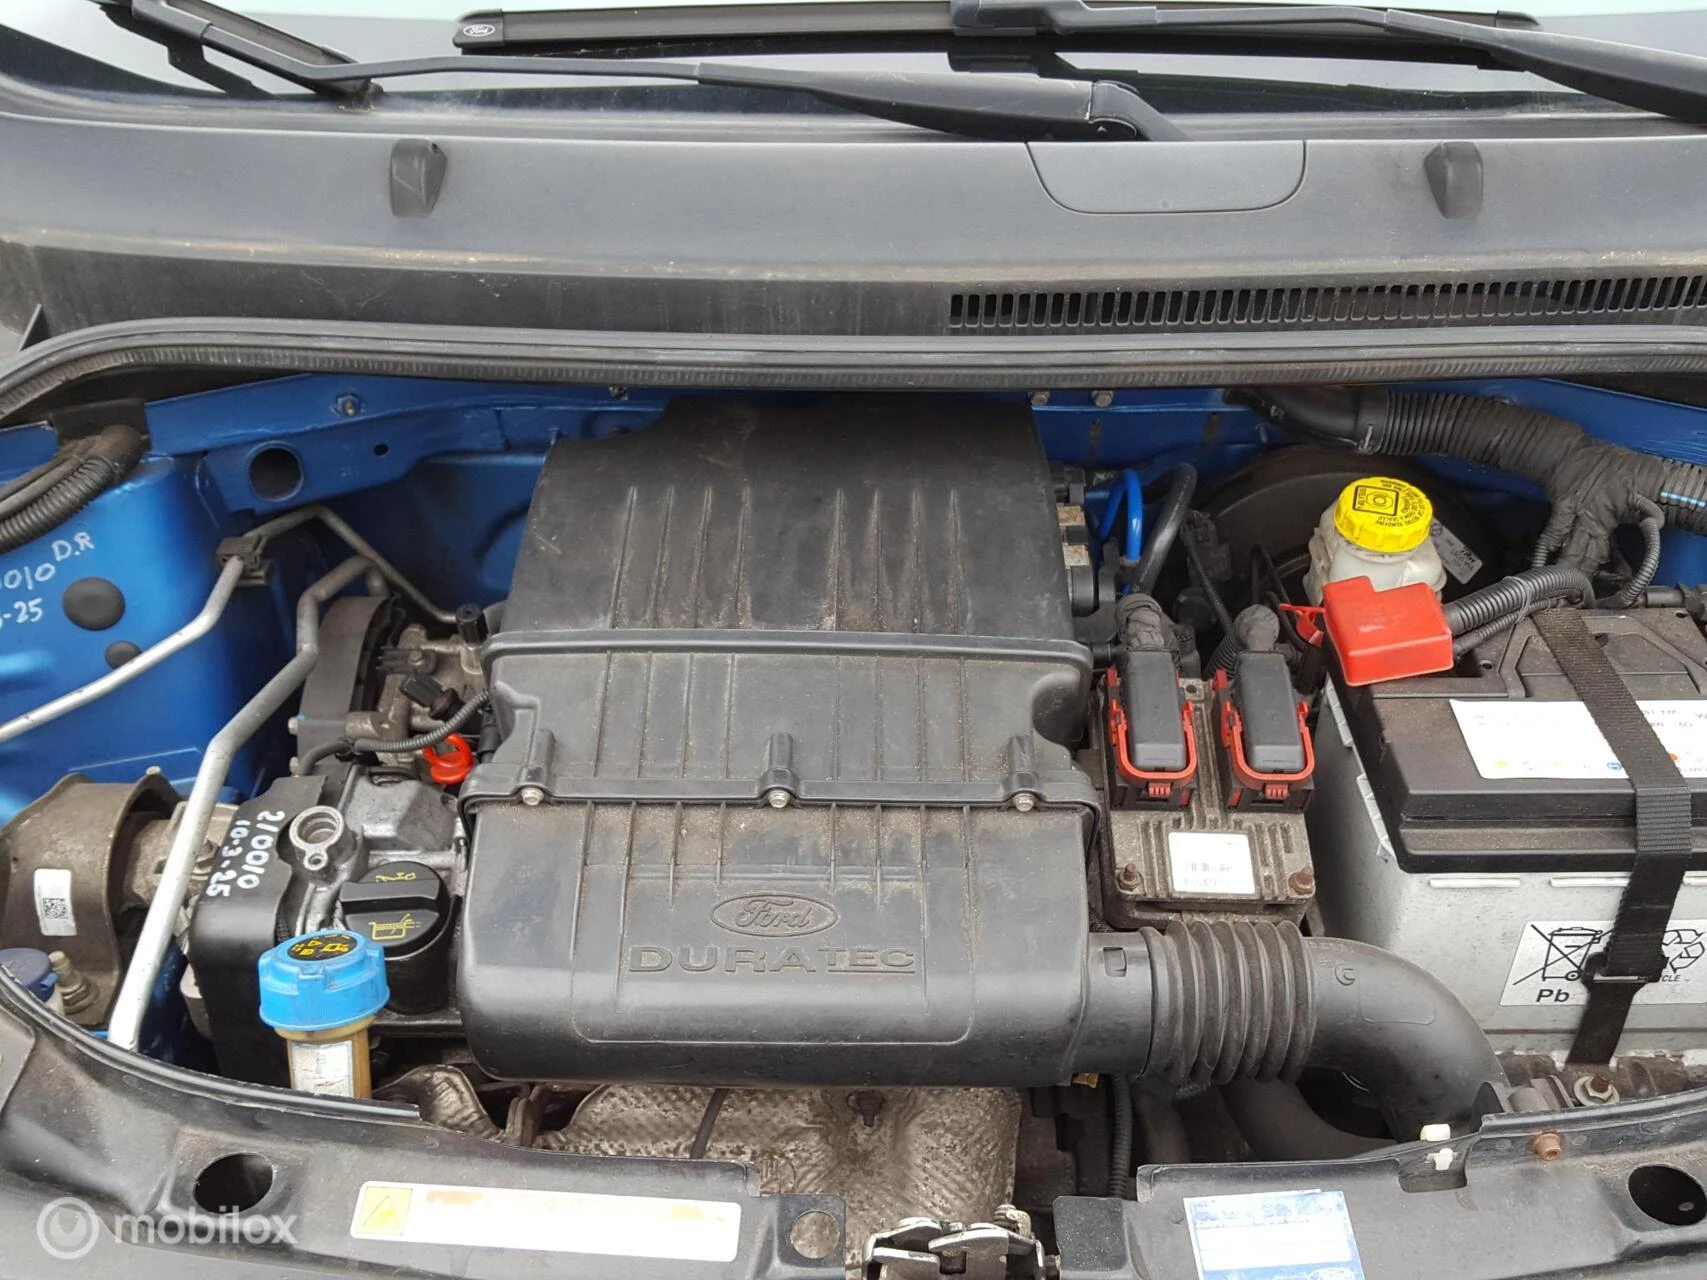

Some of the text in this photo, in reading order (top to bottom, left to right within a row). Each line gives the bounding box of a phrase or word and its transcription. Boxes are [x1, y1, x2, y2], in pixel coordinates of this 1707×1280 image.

[0, 562, 56, 590] 010
[0, 597, 42, 629] -25
[236, 810, 285, 889] 210010
[734, 899, 812, 928] Ford
[628, 946, 915, 973] DURATEC
[1536, 988, 1570, 1003] Pb
